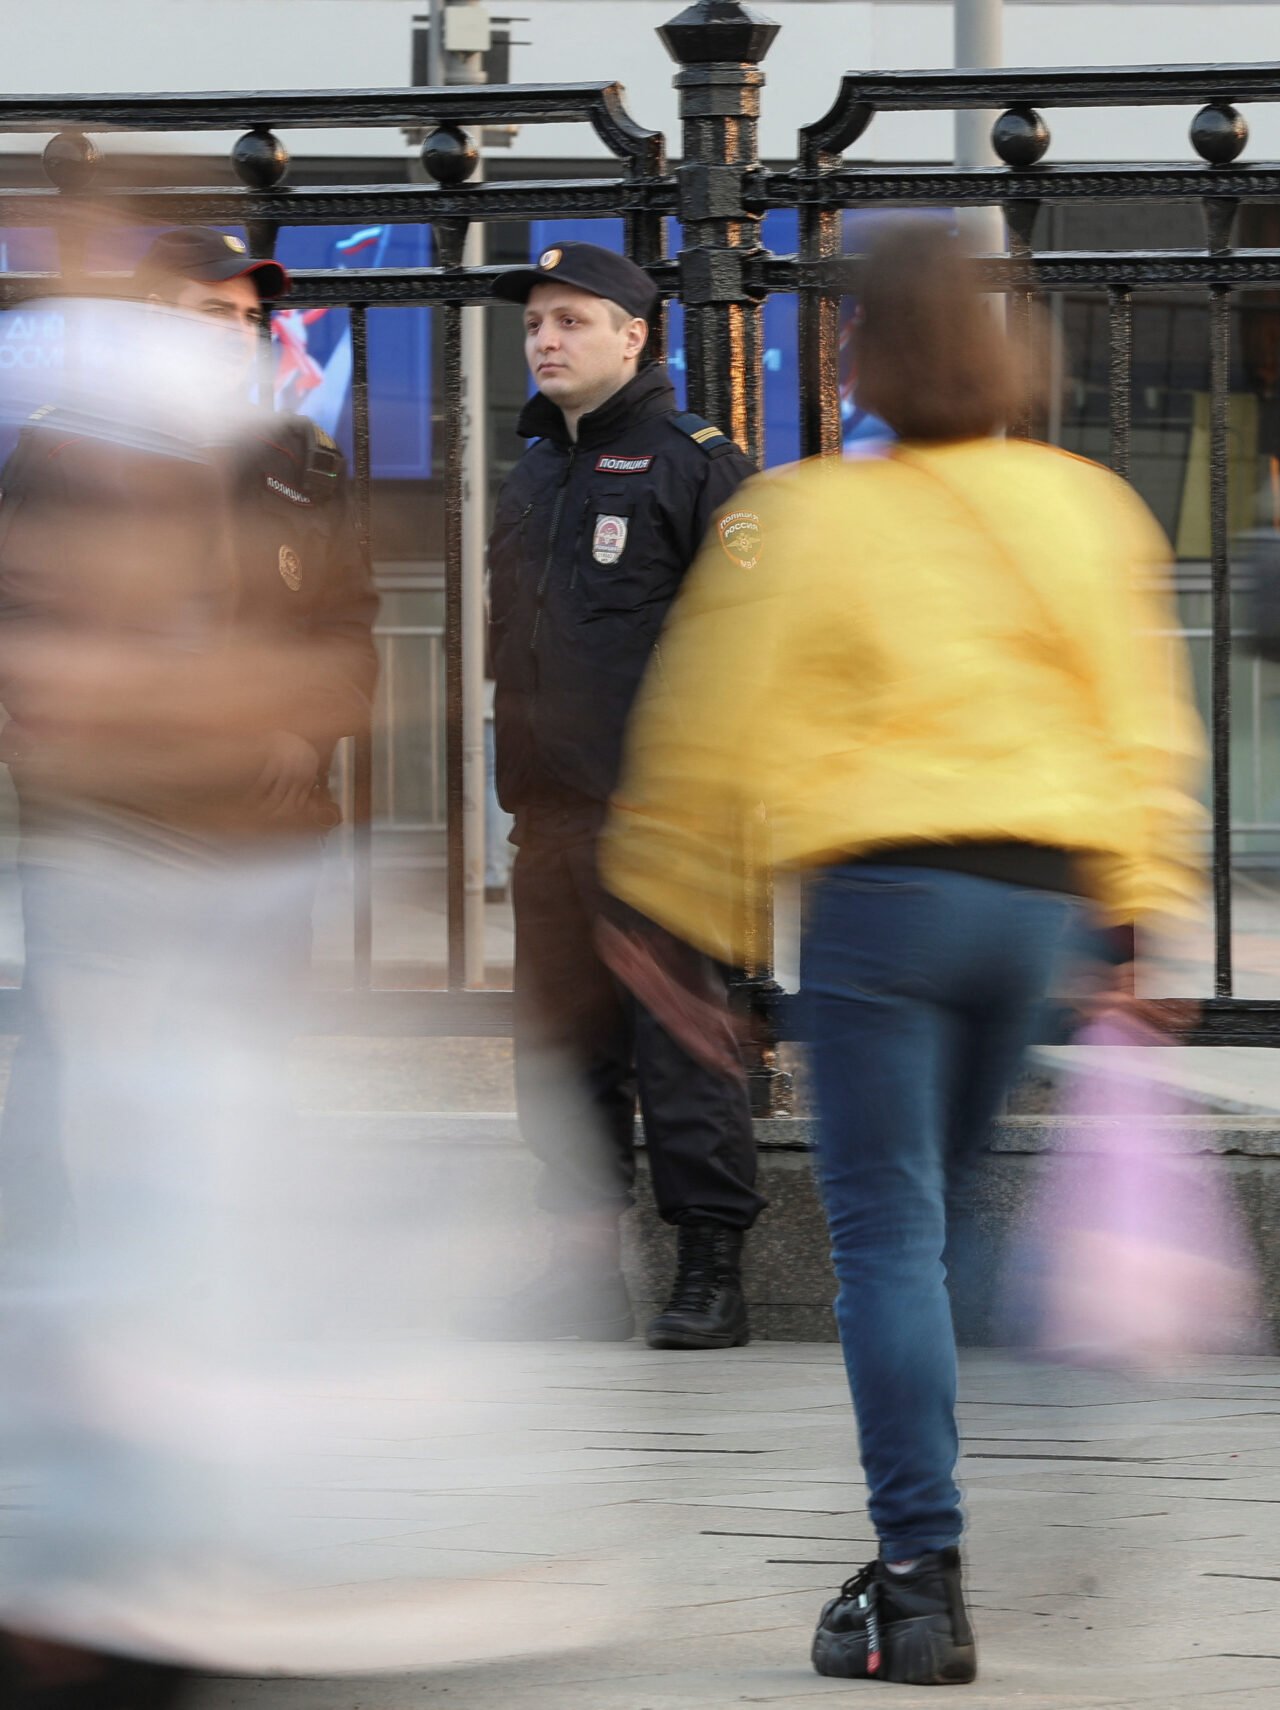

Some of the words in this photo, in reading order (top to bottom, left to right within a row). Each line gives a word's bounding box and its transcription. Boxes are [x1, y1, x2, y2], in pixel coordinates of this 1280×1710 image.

[599, 458, 649, 470] ПОЛИЦИЯ
[720, 511, 759, 529] ПОЛИЦИЯ
[725, 522, 758, 538] РОССИЯ
